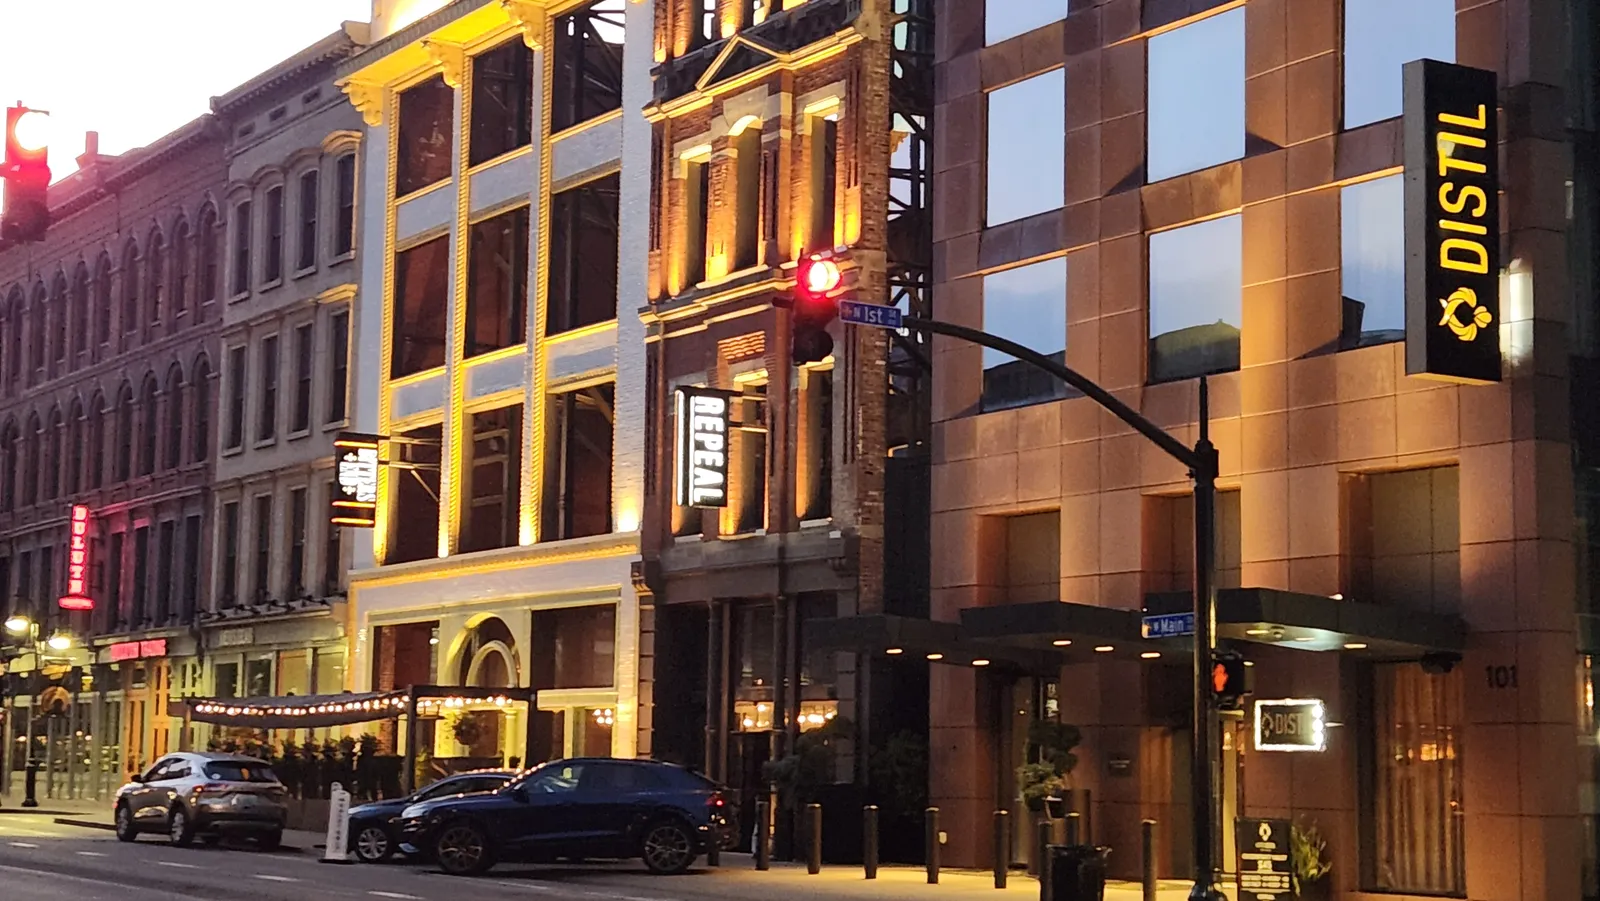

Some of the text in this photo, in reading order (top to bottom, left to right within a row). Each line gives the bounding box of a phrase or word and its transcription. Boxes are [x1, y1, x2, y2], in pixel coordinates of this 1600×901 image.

[1437, 103, 1489, 275] DISTIL
[864, 306, 883, 324] 1st
[694, 395, 725, 503] REPEAL
[1160, 618, 1184, 633] Main
[1485, 664, 1518, 689] 101
[1275, 713, 1305, 736] DIST
